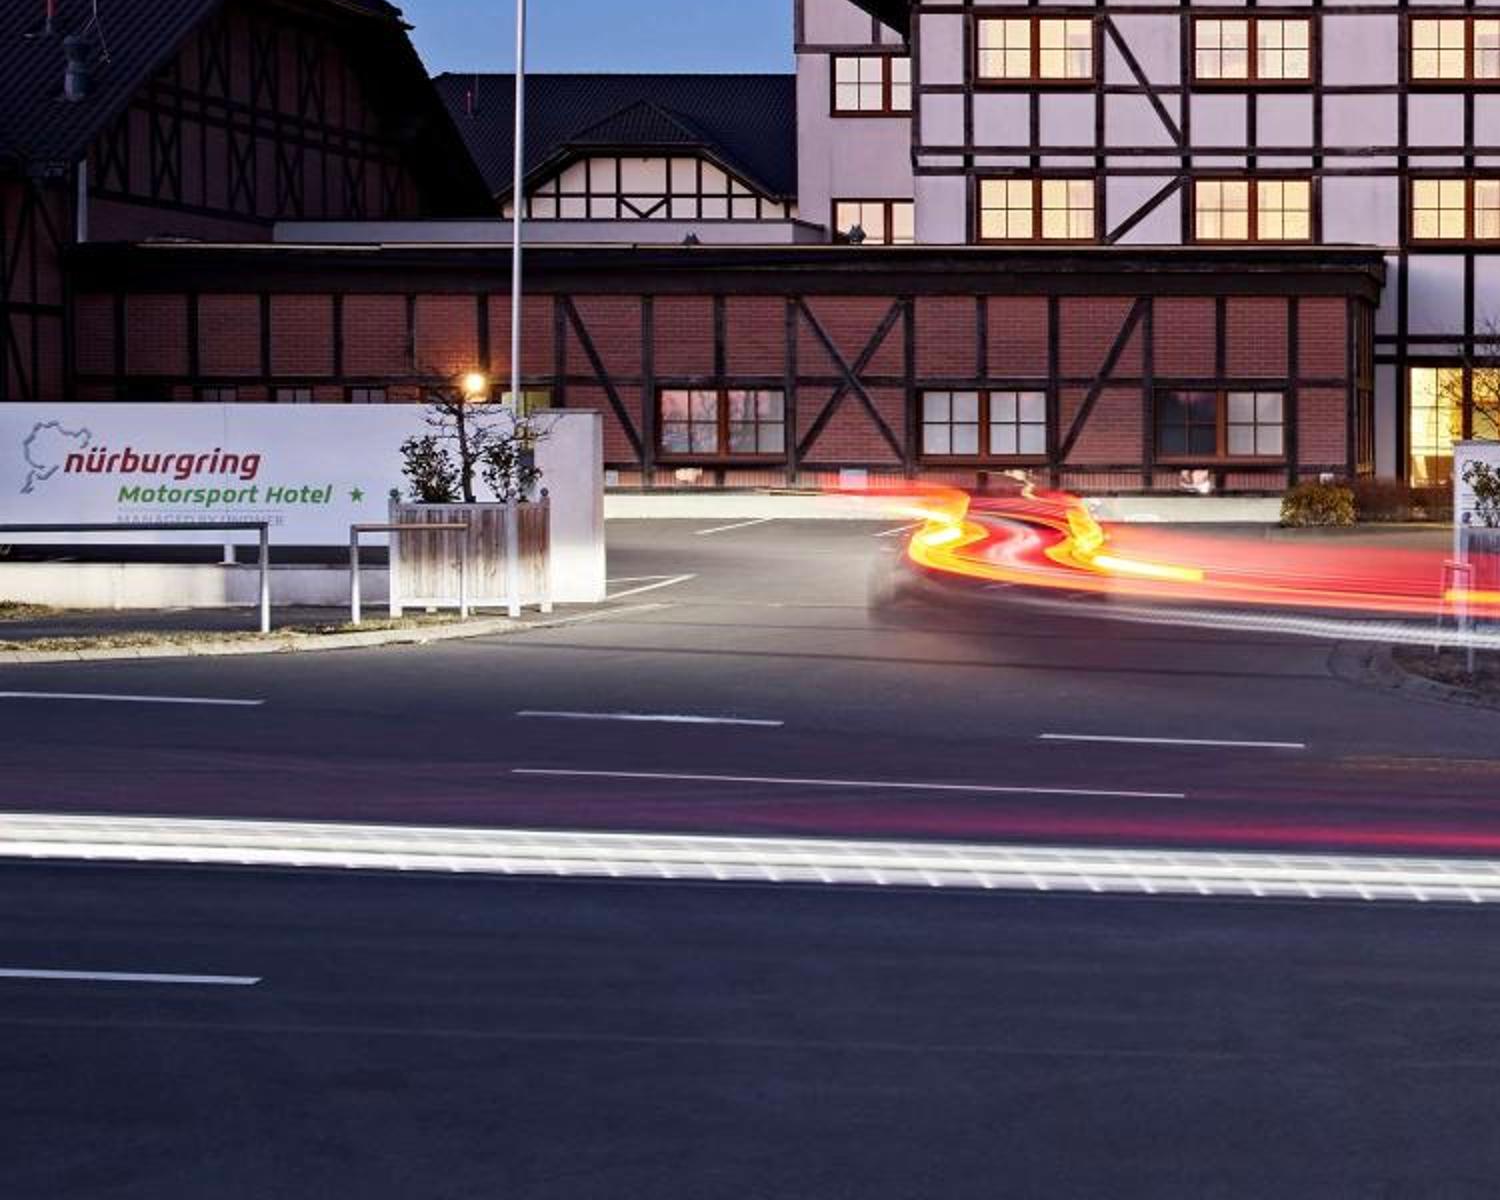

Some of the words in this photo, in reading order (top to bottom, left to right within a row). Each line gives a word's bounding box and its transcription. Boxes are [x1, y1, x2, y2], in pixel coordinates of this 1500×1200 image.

[64, 447, 260, 480] nürburgring
[117, 485, 258, 507] Motorsport
[265, 484, 332, 503] Hotel
